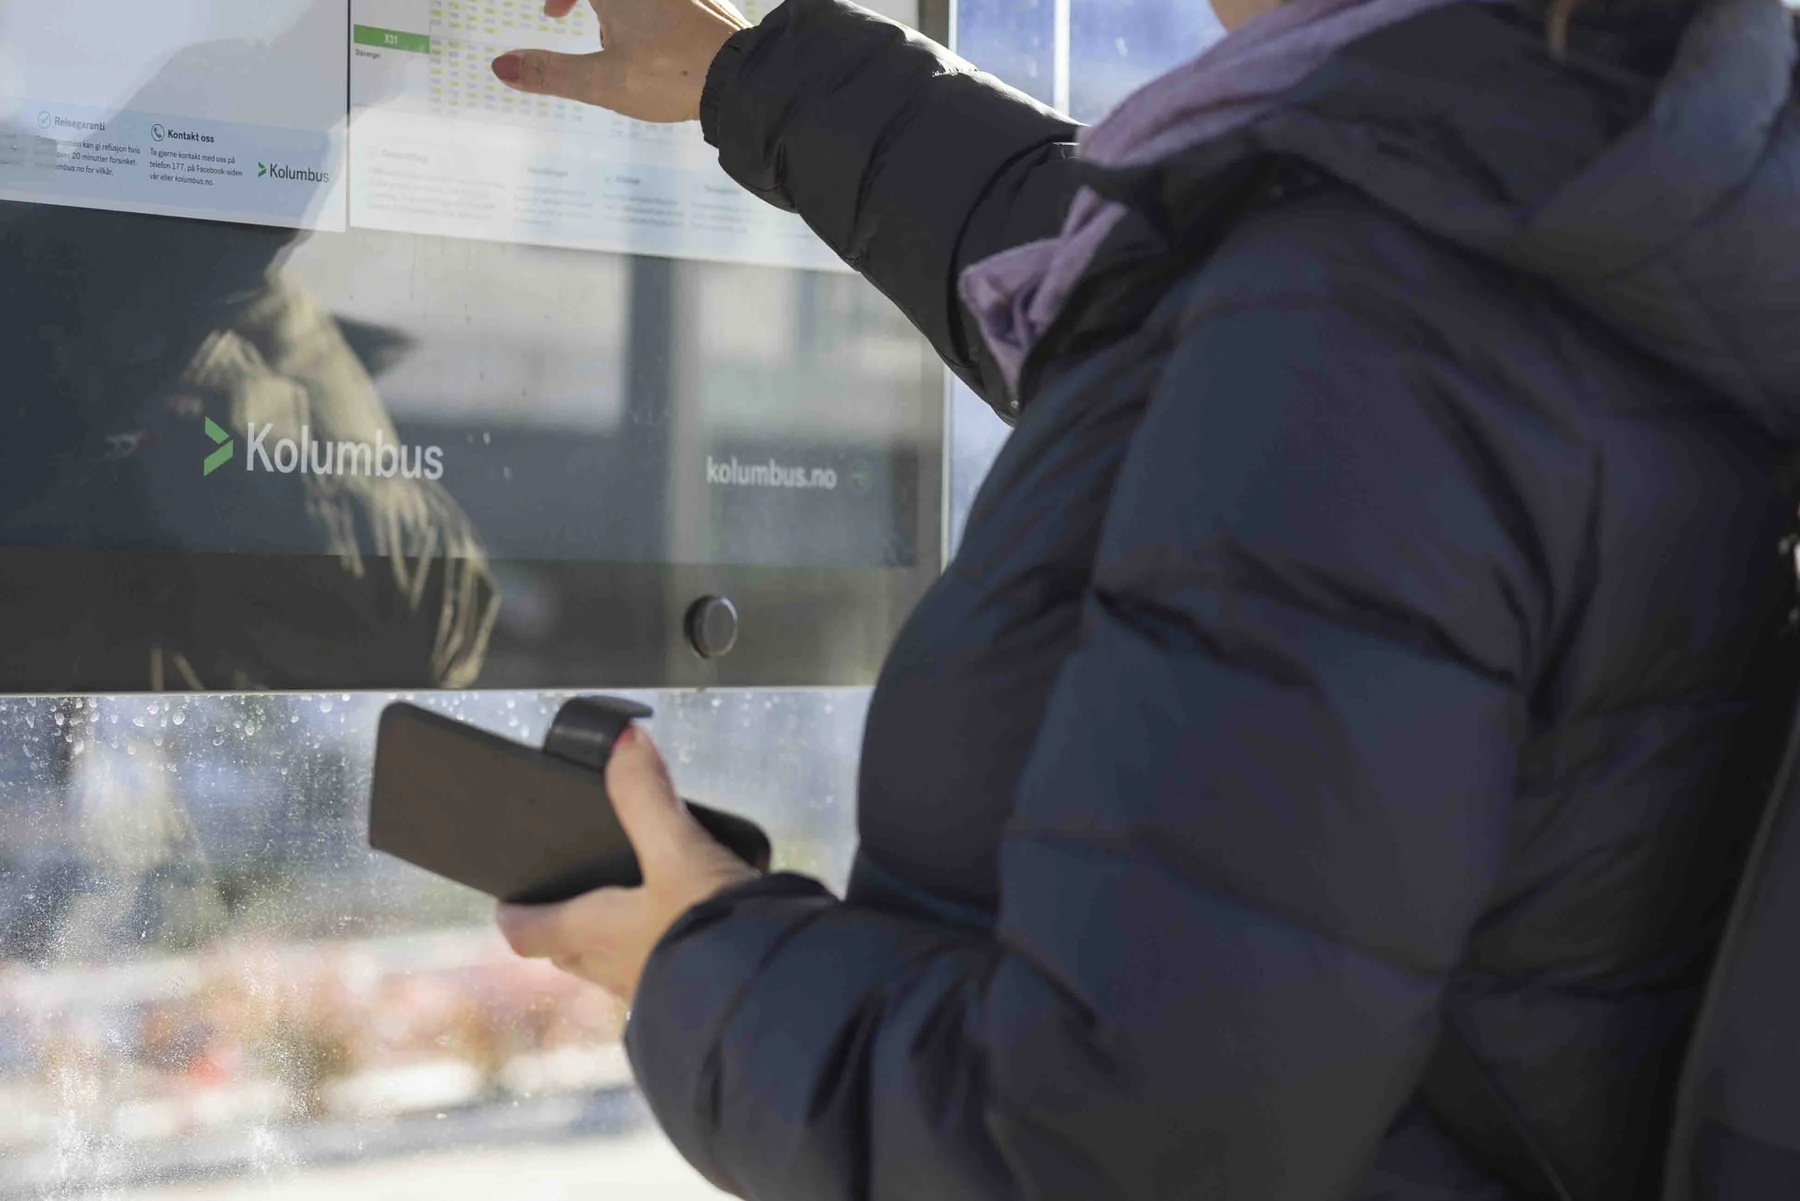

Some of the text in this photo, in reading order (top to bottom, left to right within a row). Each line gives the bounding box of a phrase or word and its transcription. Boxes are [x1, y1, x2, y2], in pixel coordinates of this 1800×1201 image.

[384, 33, 398, 45] X31
[54, 116, 106, 131] Reisegaranti
[167, 129, 215, 143] Kontakt oss
[83, 141, 94, 149] kan
[95, 142, 101, 151] gi
[102, 143, 127, 154] refusjon
[128, 146, 141, 155] hvis
[72, 152, 80, 160] 20
[81, 153, 108, 163] minutter
[150, 148, 236, 166] Ta gjerne kontakt med oss på
[86, 165, 94, 174] for
[149, 160, 171, 170] telefon
[187, 163, 196, 173] på
[196, 164, 243, 177] Facebook-siden
[269, 163, 330, 183] Kolumbus
[149, 172, 159, 181] vår
[160, 173, 174, 183] eller
[246, 421, 444, 480] Kolumbus
[706, 455, 838, 490] kolumbus.no
